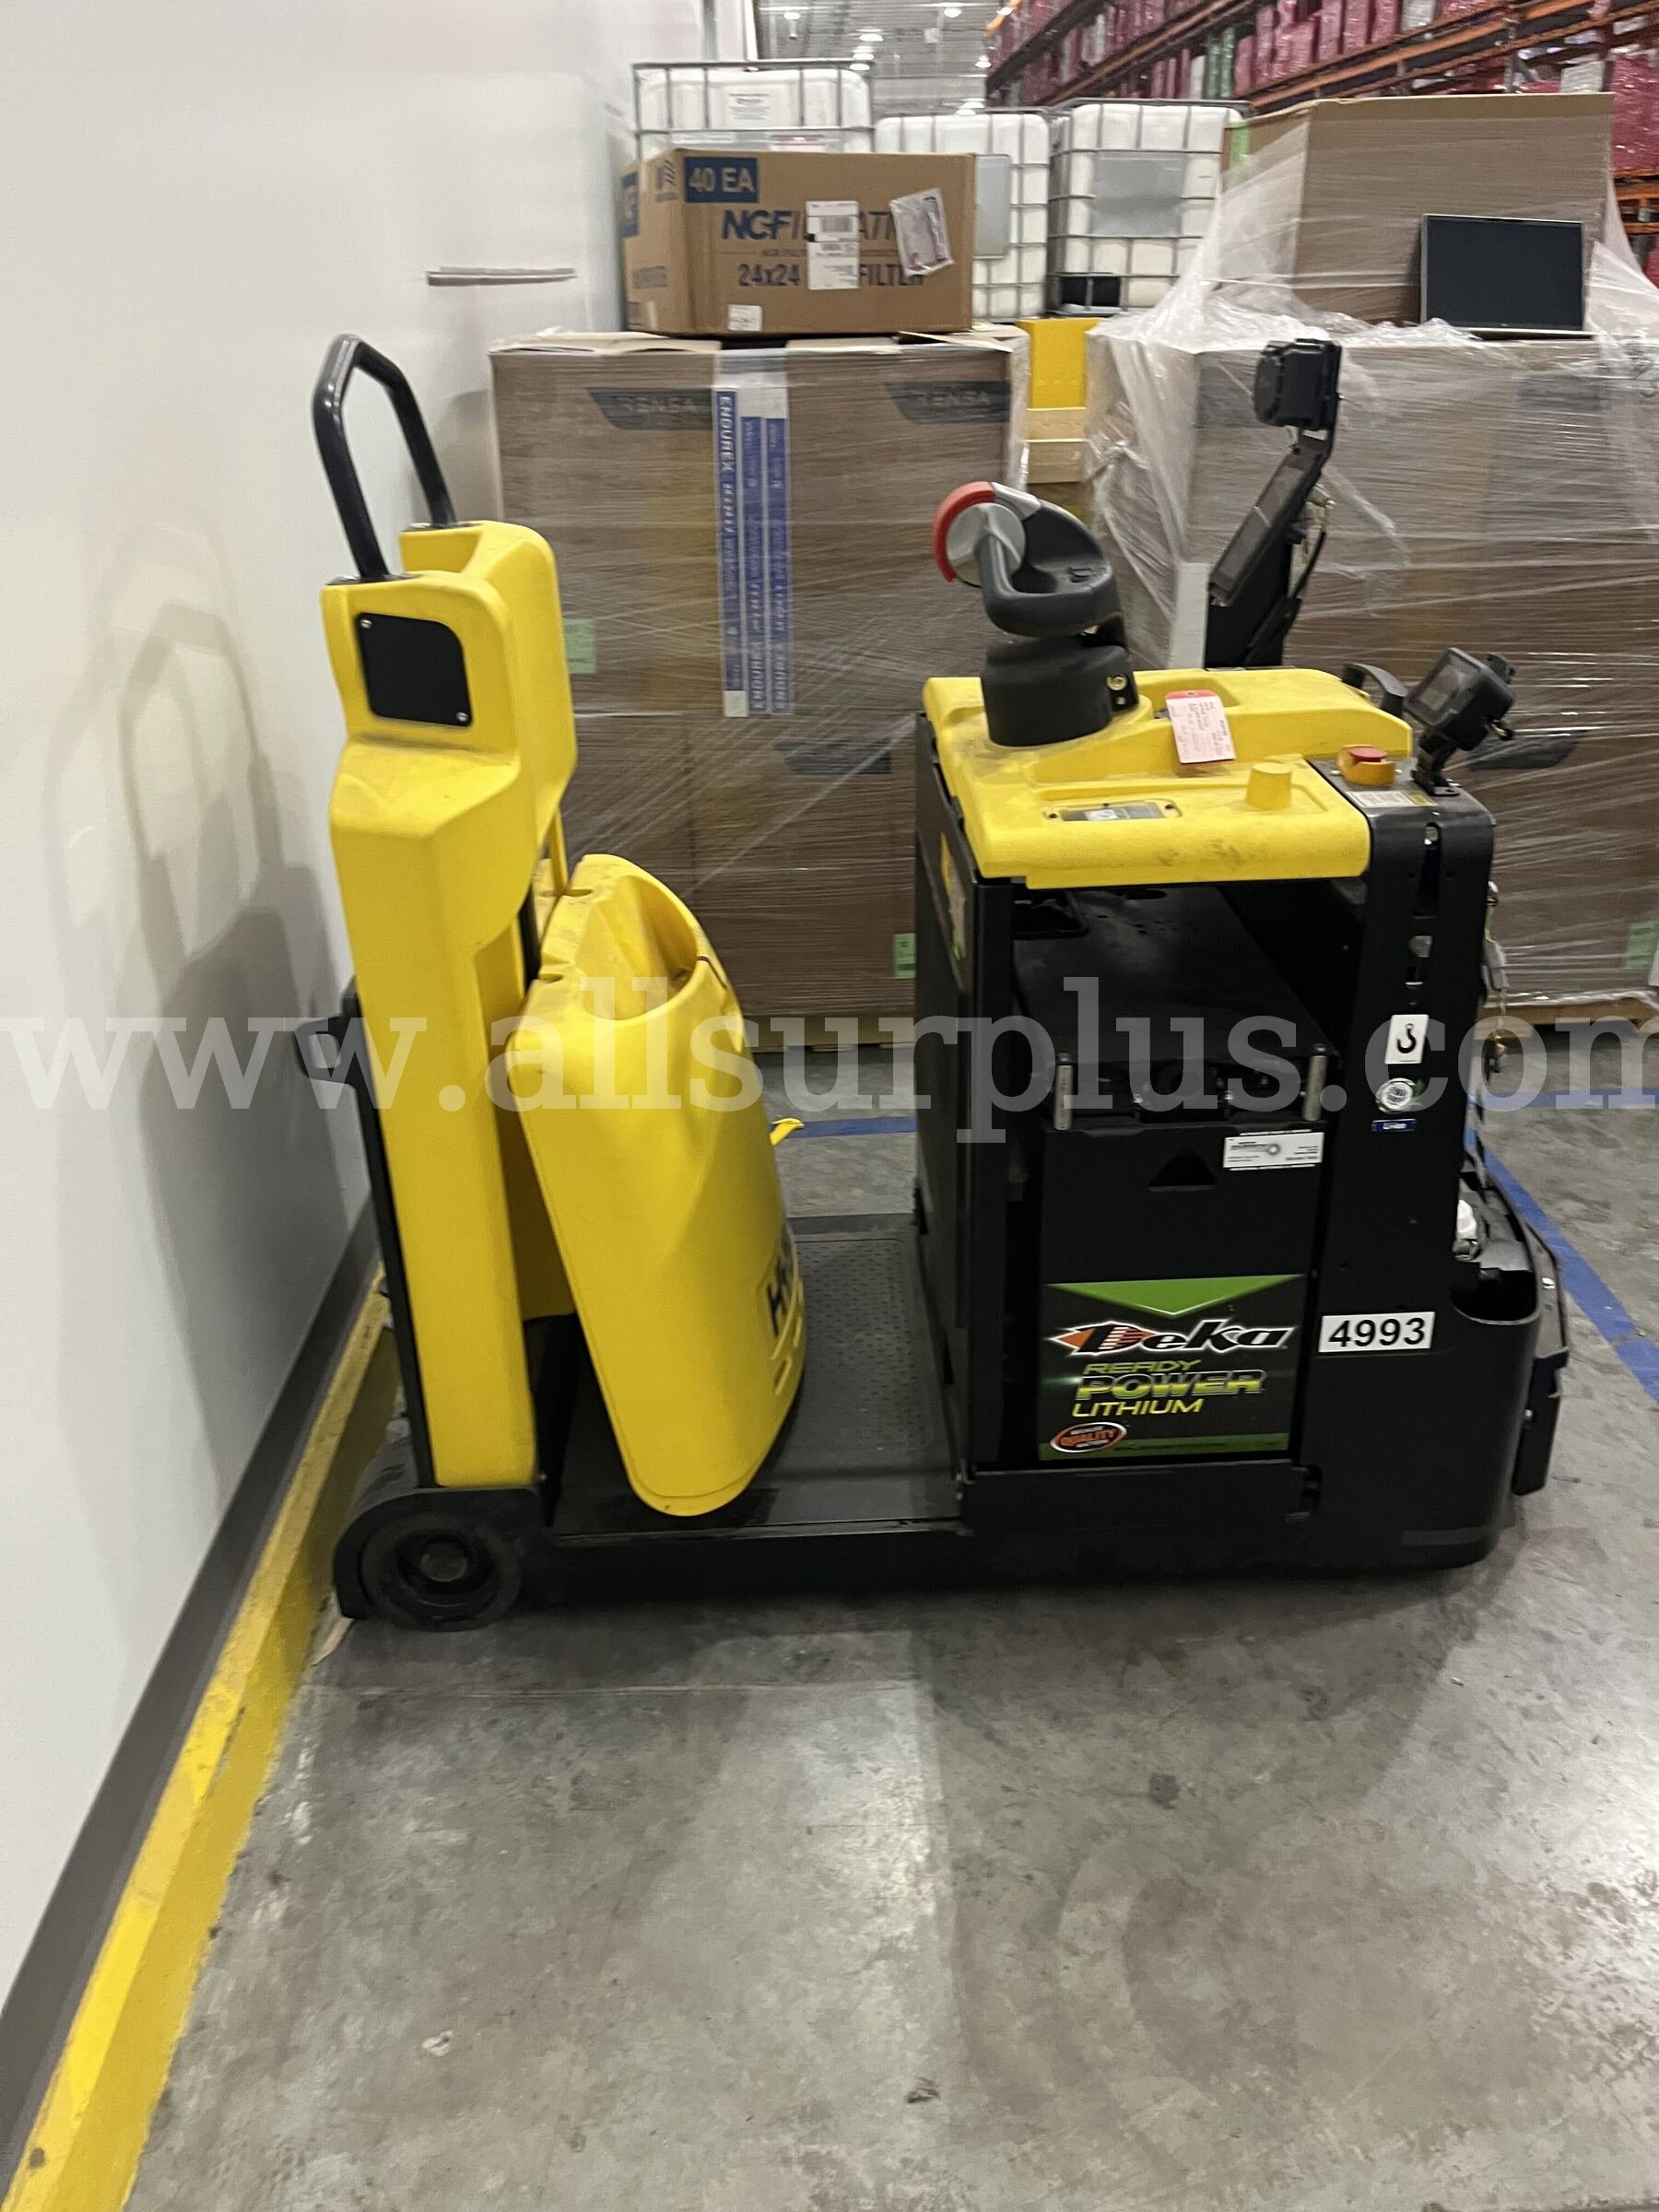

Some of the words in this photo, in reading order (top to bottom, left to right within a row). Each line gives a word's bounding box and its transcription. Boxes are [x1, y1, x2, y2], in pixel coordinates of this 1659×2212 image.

[689, 167, 716, 193] 40
[723, 167, 756, 194] EA
[1067, 1319, 1294, 1355] Deka
[1328, 1317, 1425, 1347] 4993
[1083, 1359, 1201, 1375] READY
[1074, 1370, 1267, 1401] POWER
[1072, 1400, 1203, 1418] LITHIUM
